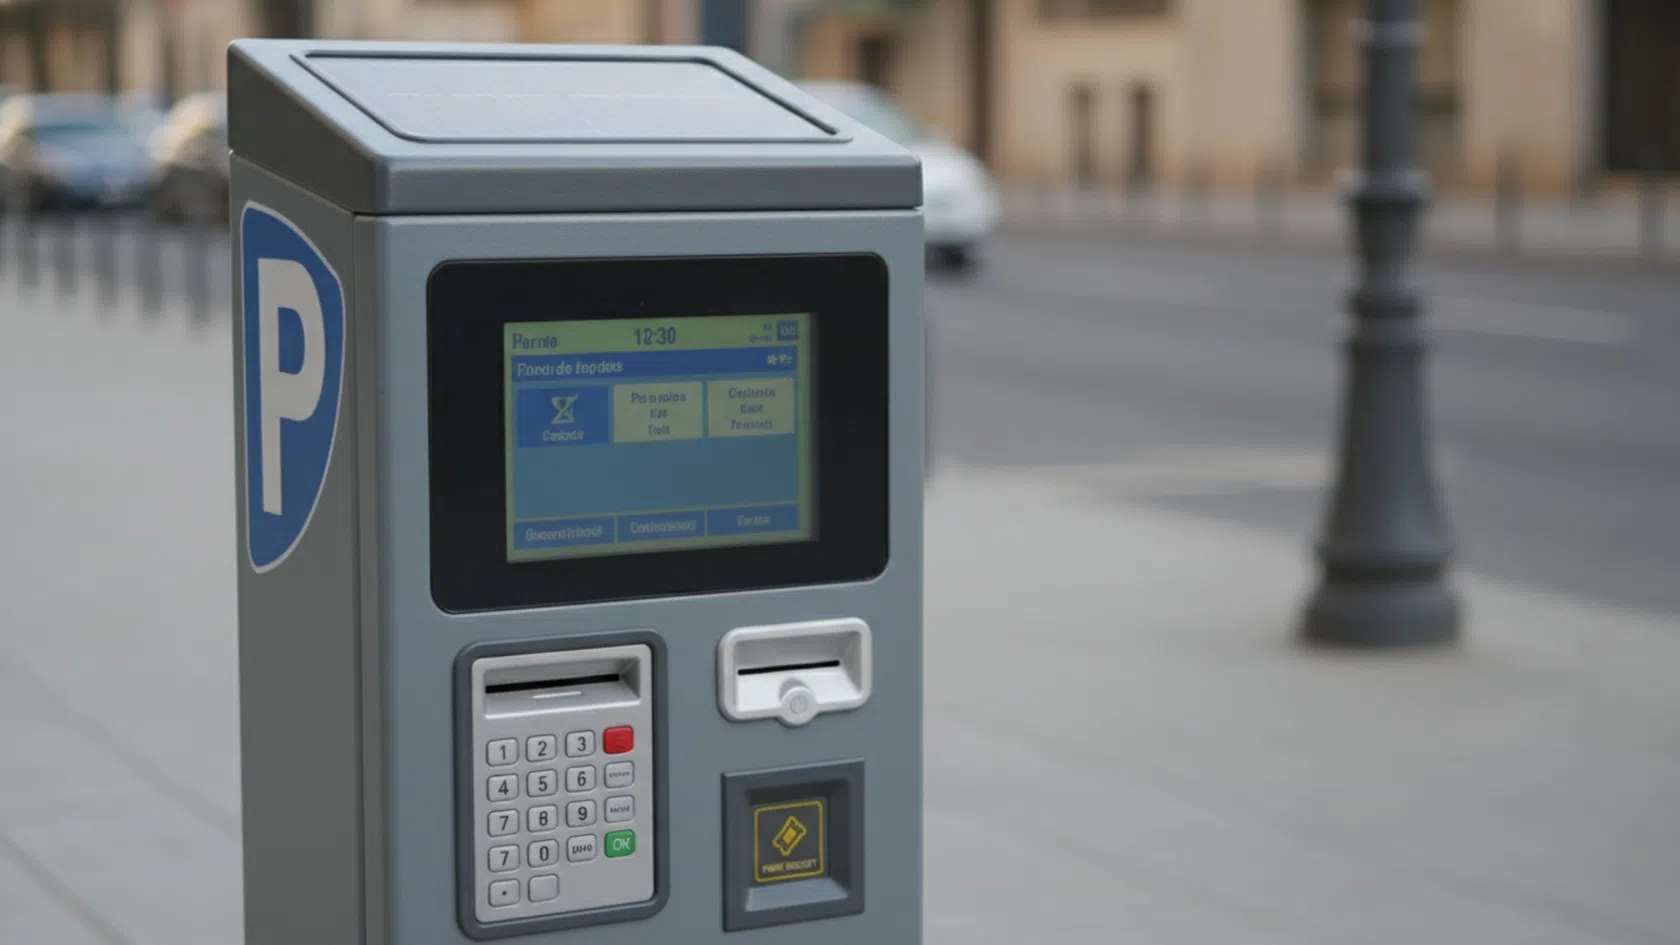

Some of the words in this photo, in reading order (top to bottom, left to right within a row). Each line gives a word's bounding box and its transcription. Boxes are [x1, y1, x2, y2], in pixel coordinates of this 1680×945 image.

[258, 257, 326, 516] P
[499, 744, 507, 761] 1
[537, 740, 547, 757] 2
[577, 736, 587, 752] 3
[498, 780, 509, 796] 4
[538, 776, 548, 792] 5
[577, 771, 587, 787] 6
[499, 816, 510, 831] 7
[538, 811, 549, 827] 8
[578, 806, 588, 821] 9
[499, 851, 510, 866] 7
[612, 837, 631, 851] OK
